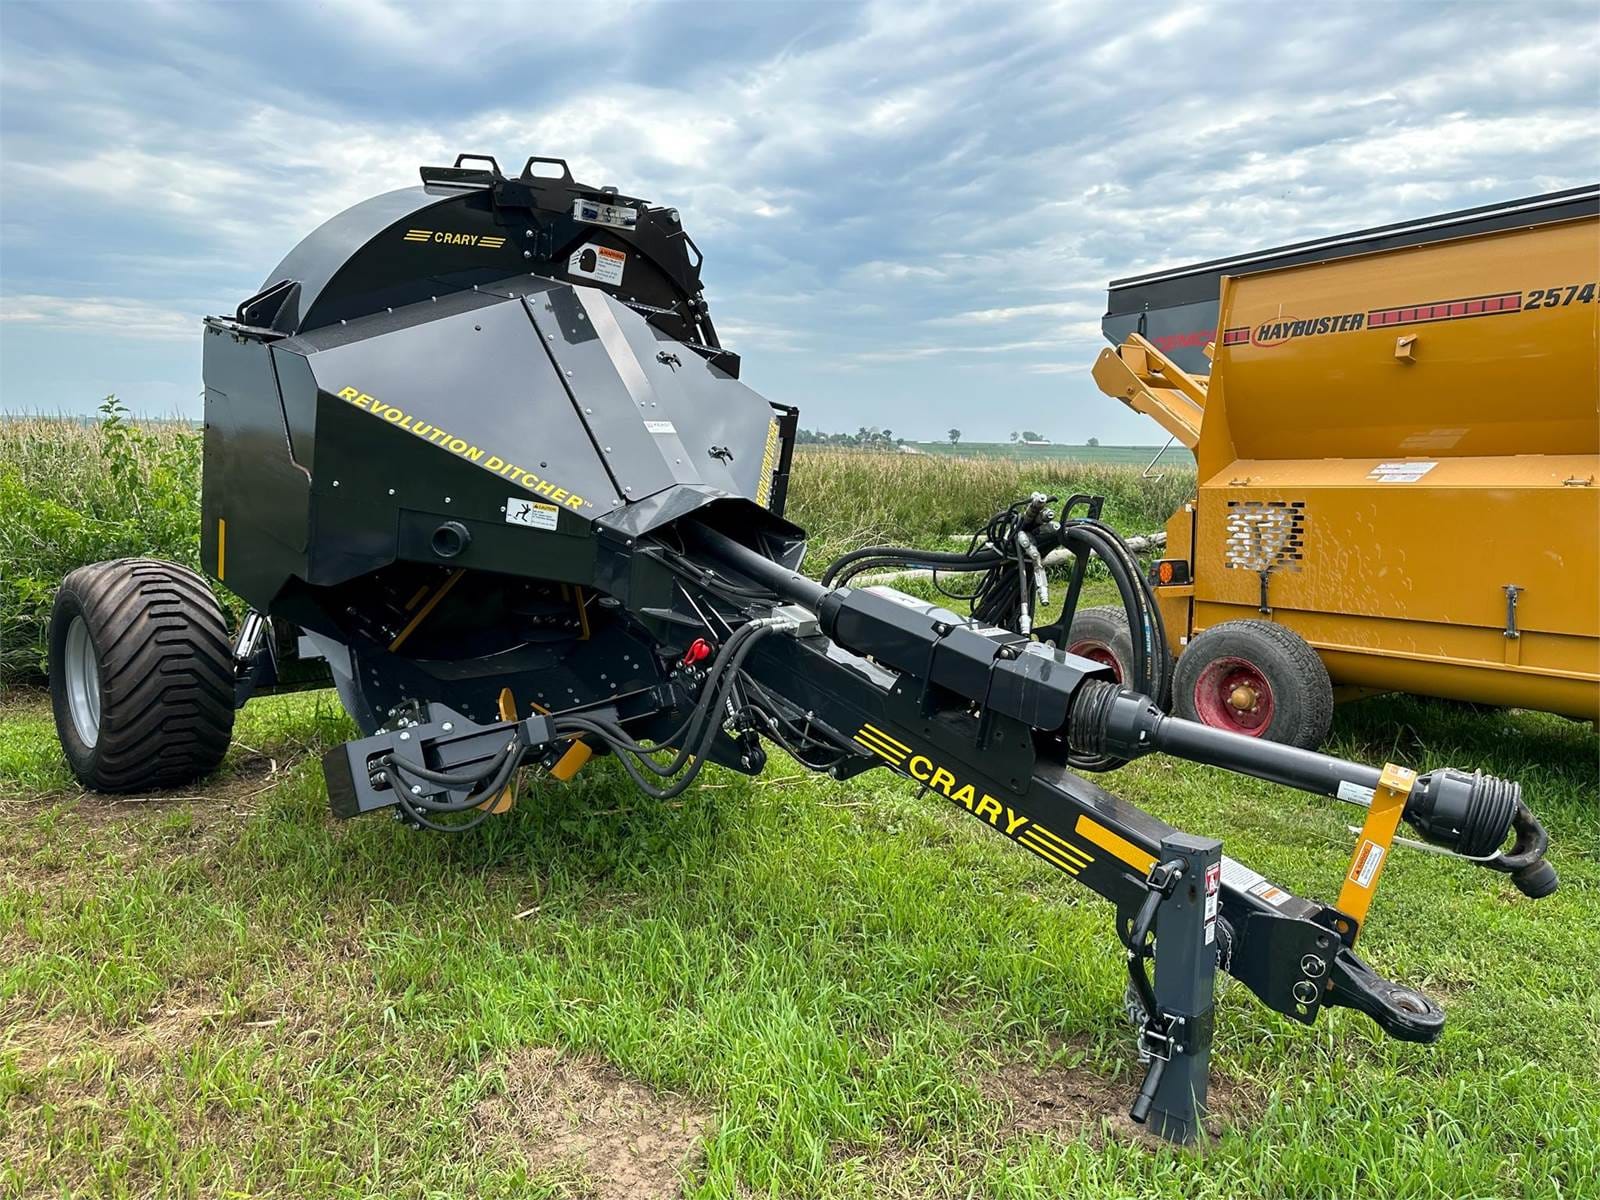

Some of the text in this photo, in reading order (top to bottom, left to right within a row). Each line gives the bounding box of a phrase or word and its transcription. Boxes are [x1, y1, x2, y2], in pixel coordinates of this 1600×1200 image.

[434, 232, 478, 246] CRARY
[1257, 313, 1365, 342] HAYBUSTER
[336, 386, 486, 462] REVOLUTION
[909, 755, 1029, 835] CRARY
